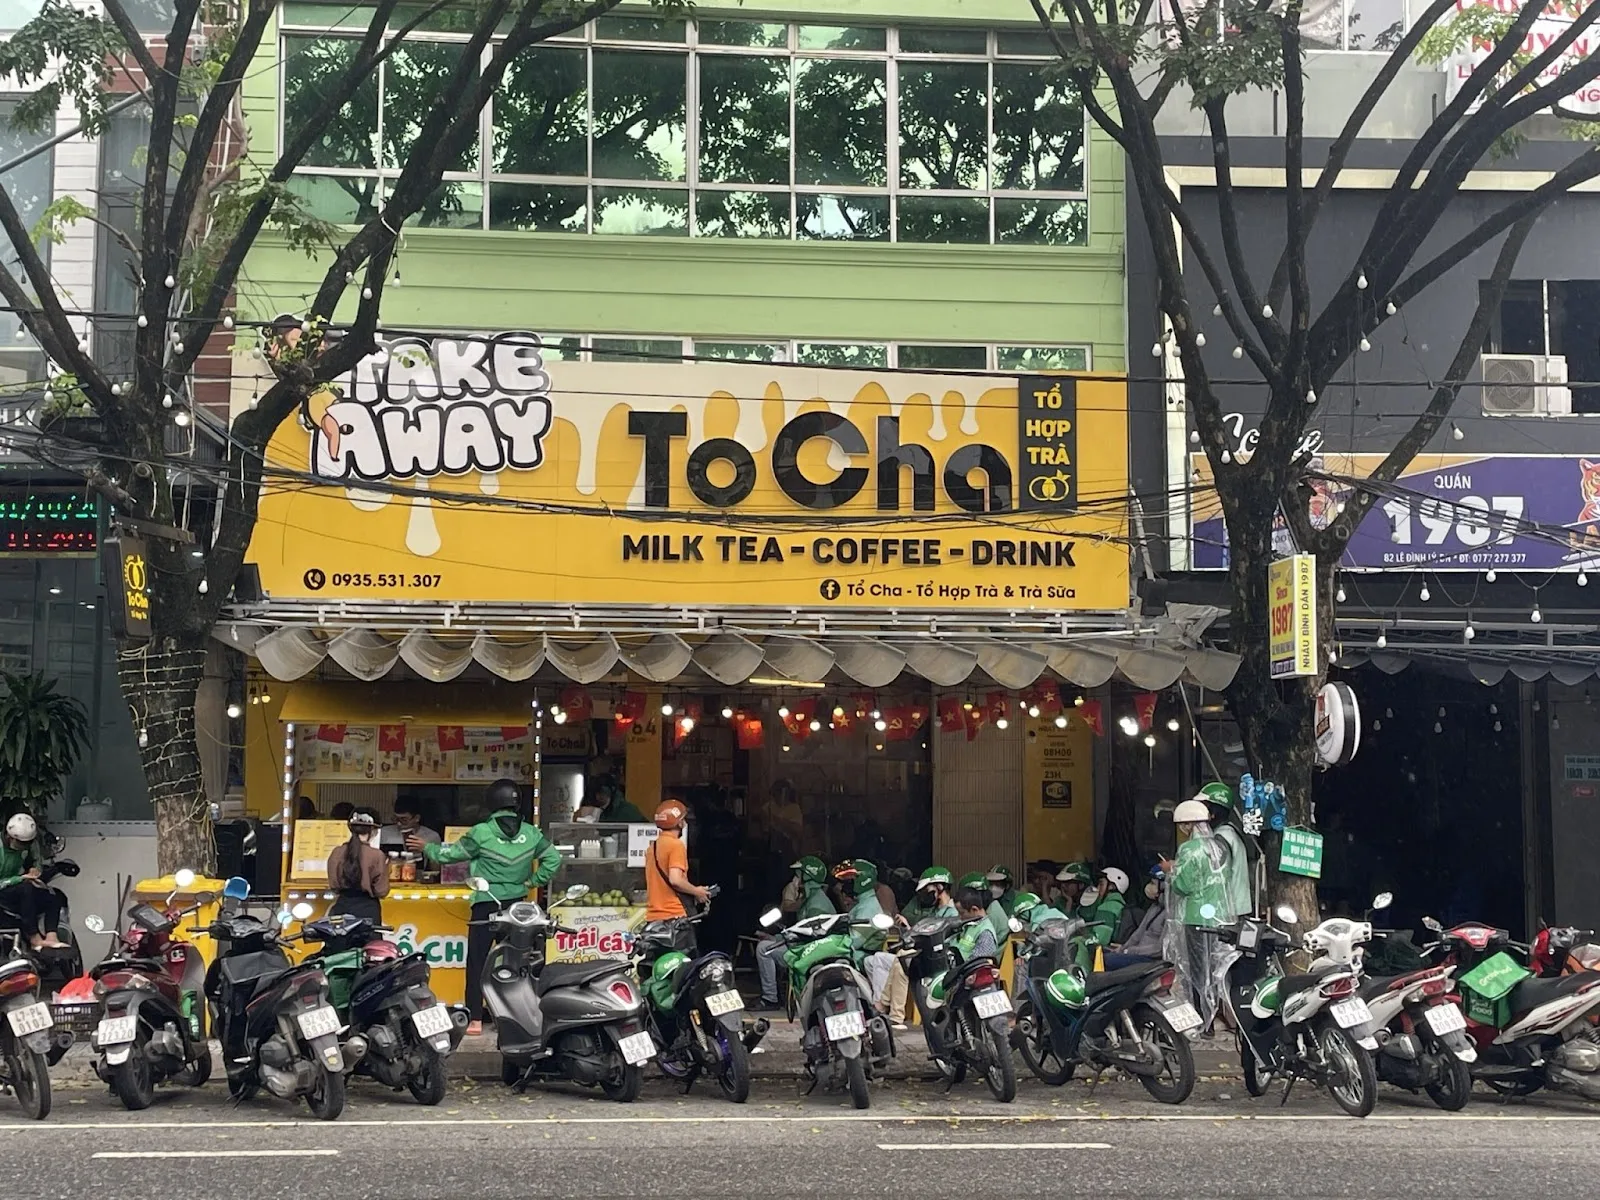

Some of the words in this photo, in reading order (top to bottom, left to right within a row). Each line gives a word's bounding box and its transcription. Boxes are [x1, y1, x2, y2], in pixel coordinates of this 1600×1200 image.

[1033, 382, 1062, 409] TỔ
[312, 396, 552, 480] AWAY
[1025, 419, 1071, 442] HỢP
[1026, 442, 1071, 465] TRÀ
[1433, 471, 1472, 490] QUÁN
[1382, 495, 1525, 547] 1987
[623, 535, 704, 562] MILK
[715, 536, 784, 563] TEA
[812, 538, 941, 565] COFFEE
[971, 540, 1076, 567] DRINK
[1383, 553, 1394, 563] 82
[1511, 553, 1526, 563] 377
[332, 573, 442, 588] 0935.531.307
[1301, 562, 1309, 585] 1987
[847, 579, 865, 597] Tổ
[870, 584, 902, 597] Cha
[916, 580, 934, 597] Tổ
[939, 584, 970, 601] Hợp
[975, 584, 998, 598] Trà
[1003, 585, 1014, 598] &
[1019, 584, 1042, 598] Trà
[1047, 584, 1076, 598] Sữa
[1271, 602, 1294, 637] 1987
[423, 941, 464, 962] CH
[18, 1016, 47, 1034] 0102
